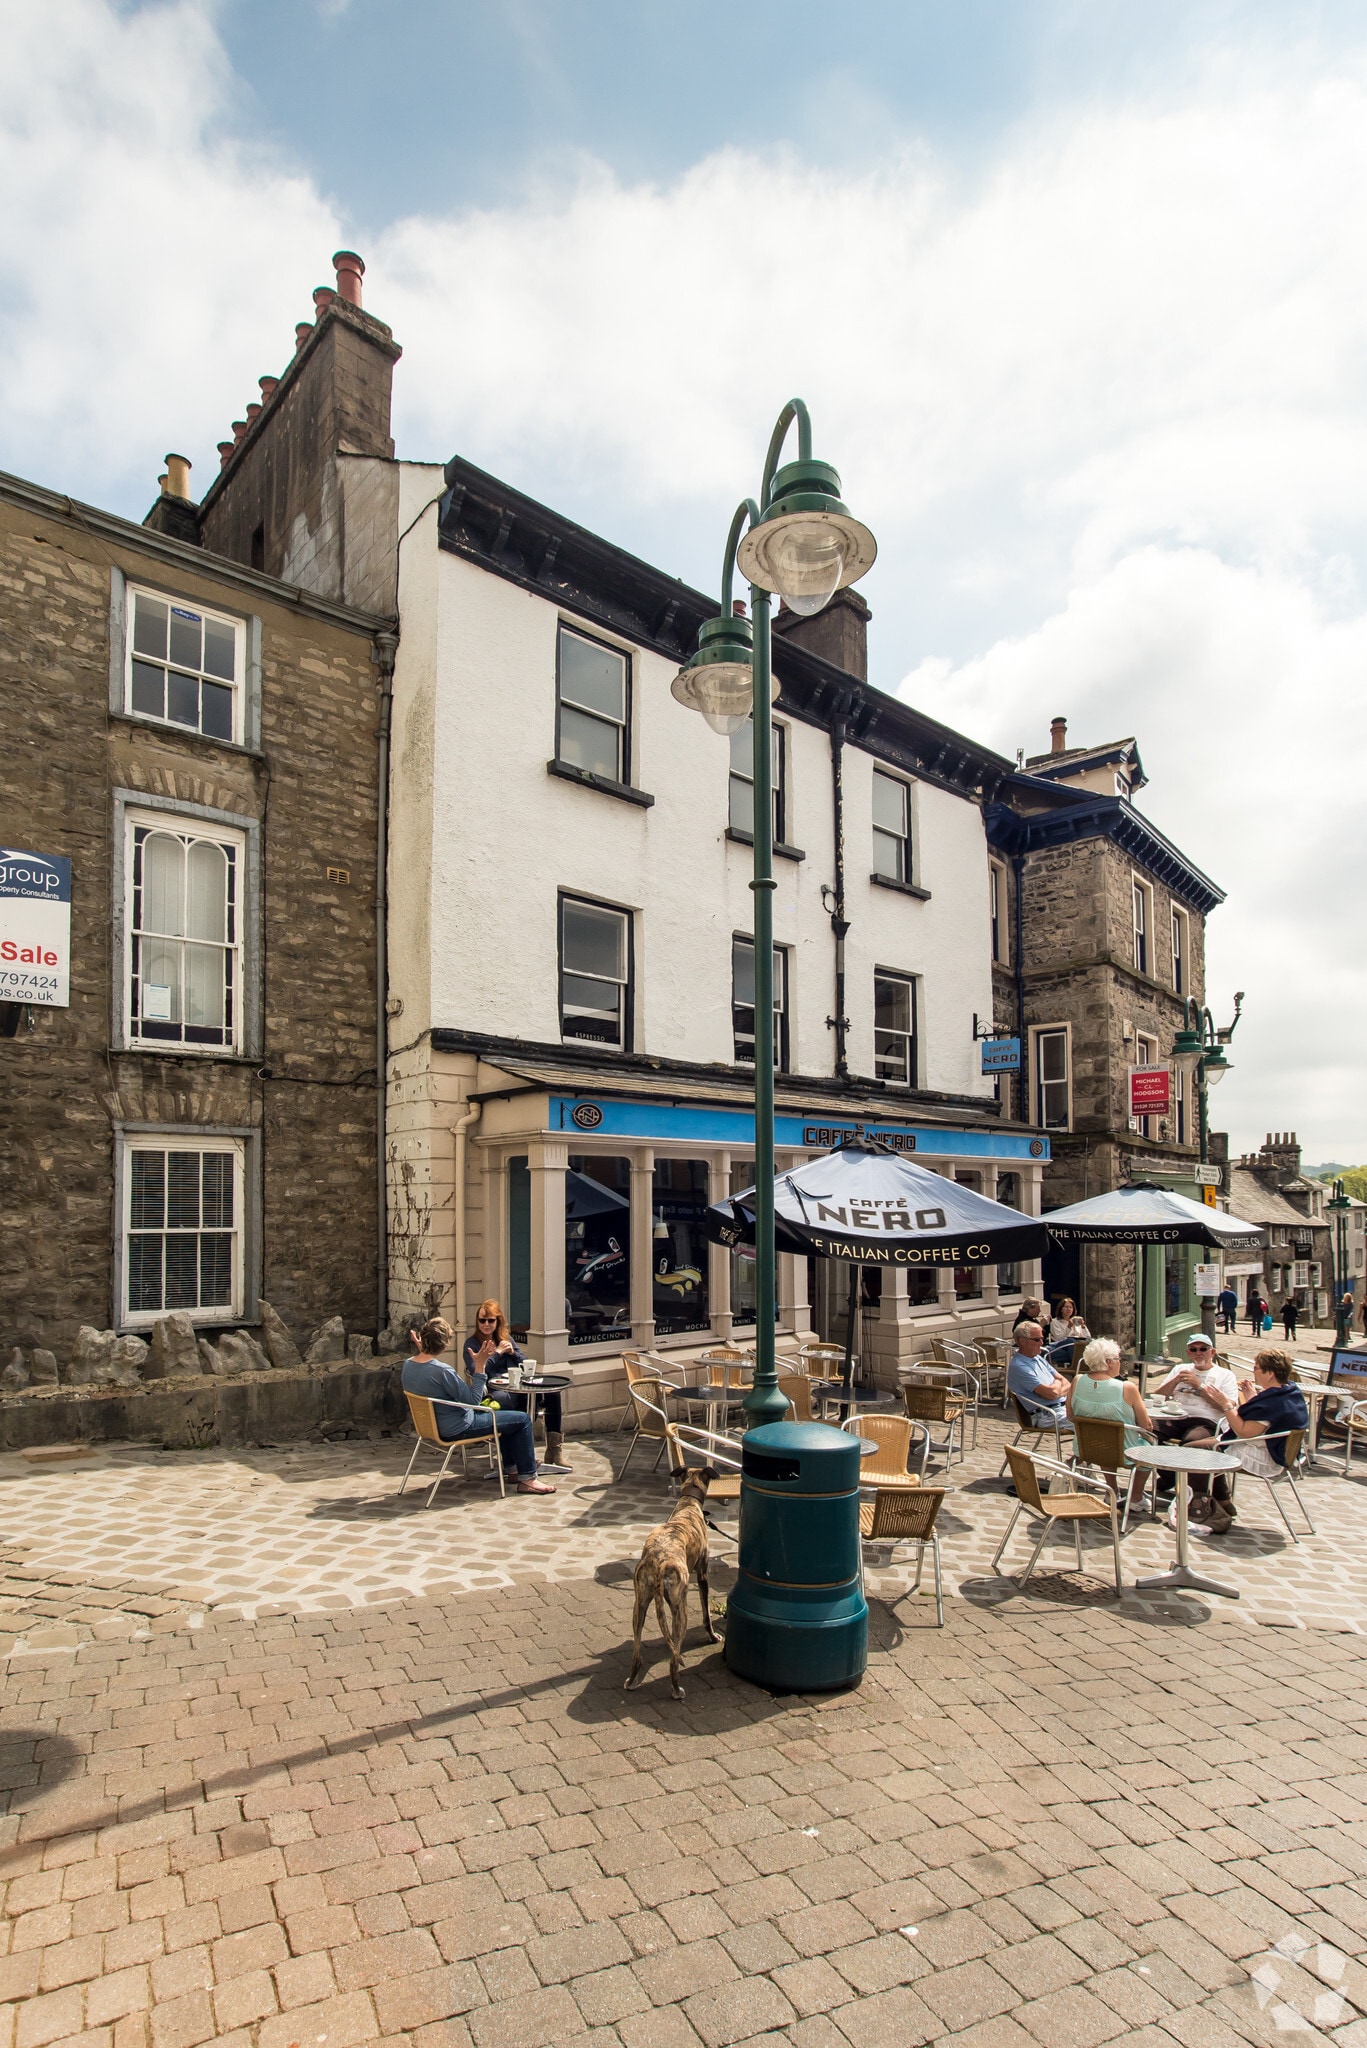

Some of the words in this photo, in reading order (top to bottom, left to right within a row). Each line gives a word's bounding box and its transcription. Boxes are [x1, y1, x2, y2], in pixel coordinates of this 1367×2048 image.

[21, 888, 60, 900] Consultants
[0, 941, 58, 967] Sale
[0, 971, 58, 990] 797424
[575, 1032, 606, 1042] ESPRESSO
[983, 1054, 1018, 1064] NERO
[850, 1197, 908, 1208] CAFFÈ
[817, 1201, 947, 1231] NERO
[1073, 1230, 1113, 1239] ITALIAN
[1115, 1230, 1160, 1240] COFFEE
[829, 1242, 890, 1261] ITALIAN
[894, 1248, 961, 1262] COFFEE
[573, 1332, 620, 1343] CAPPUCCINO
